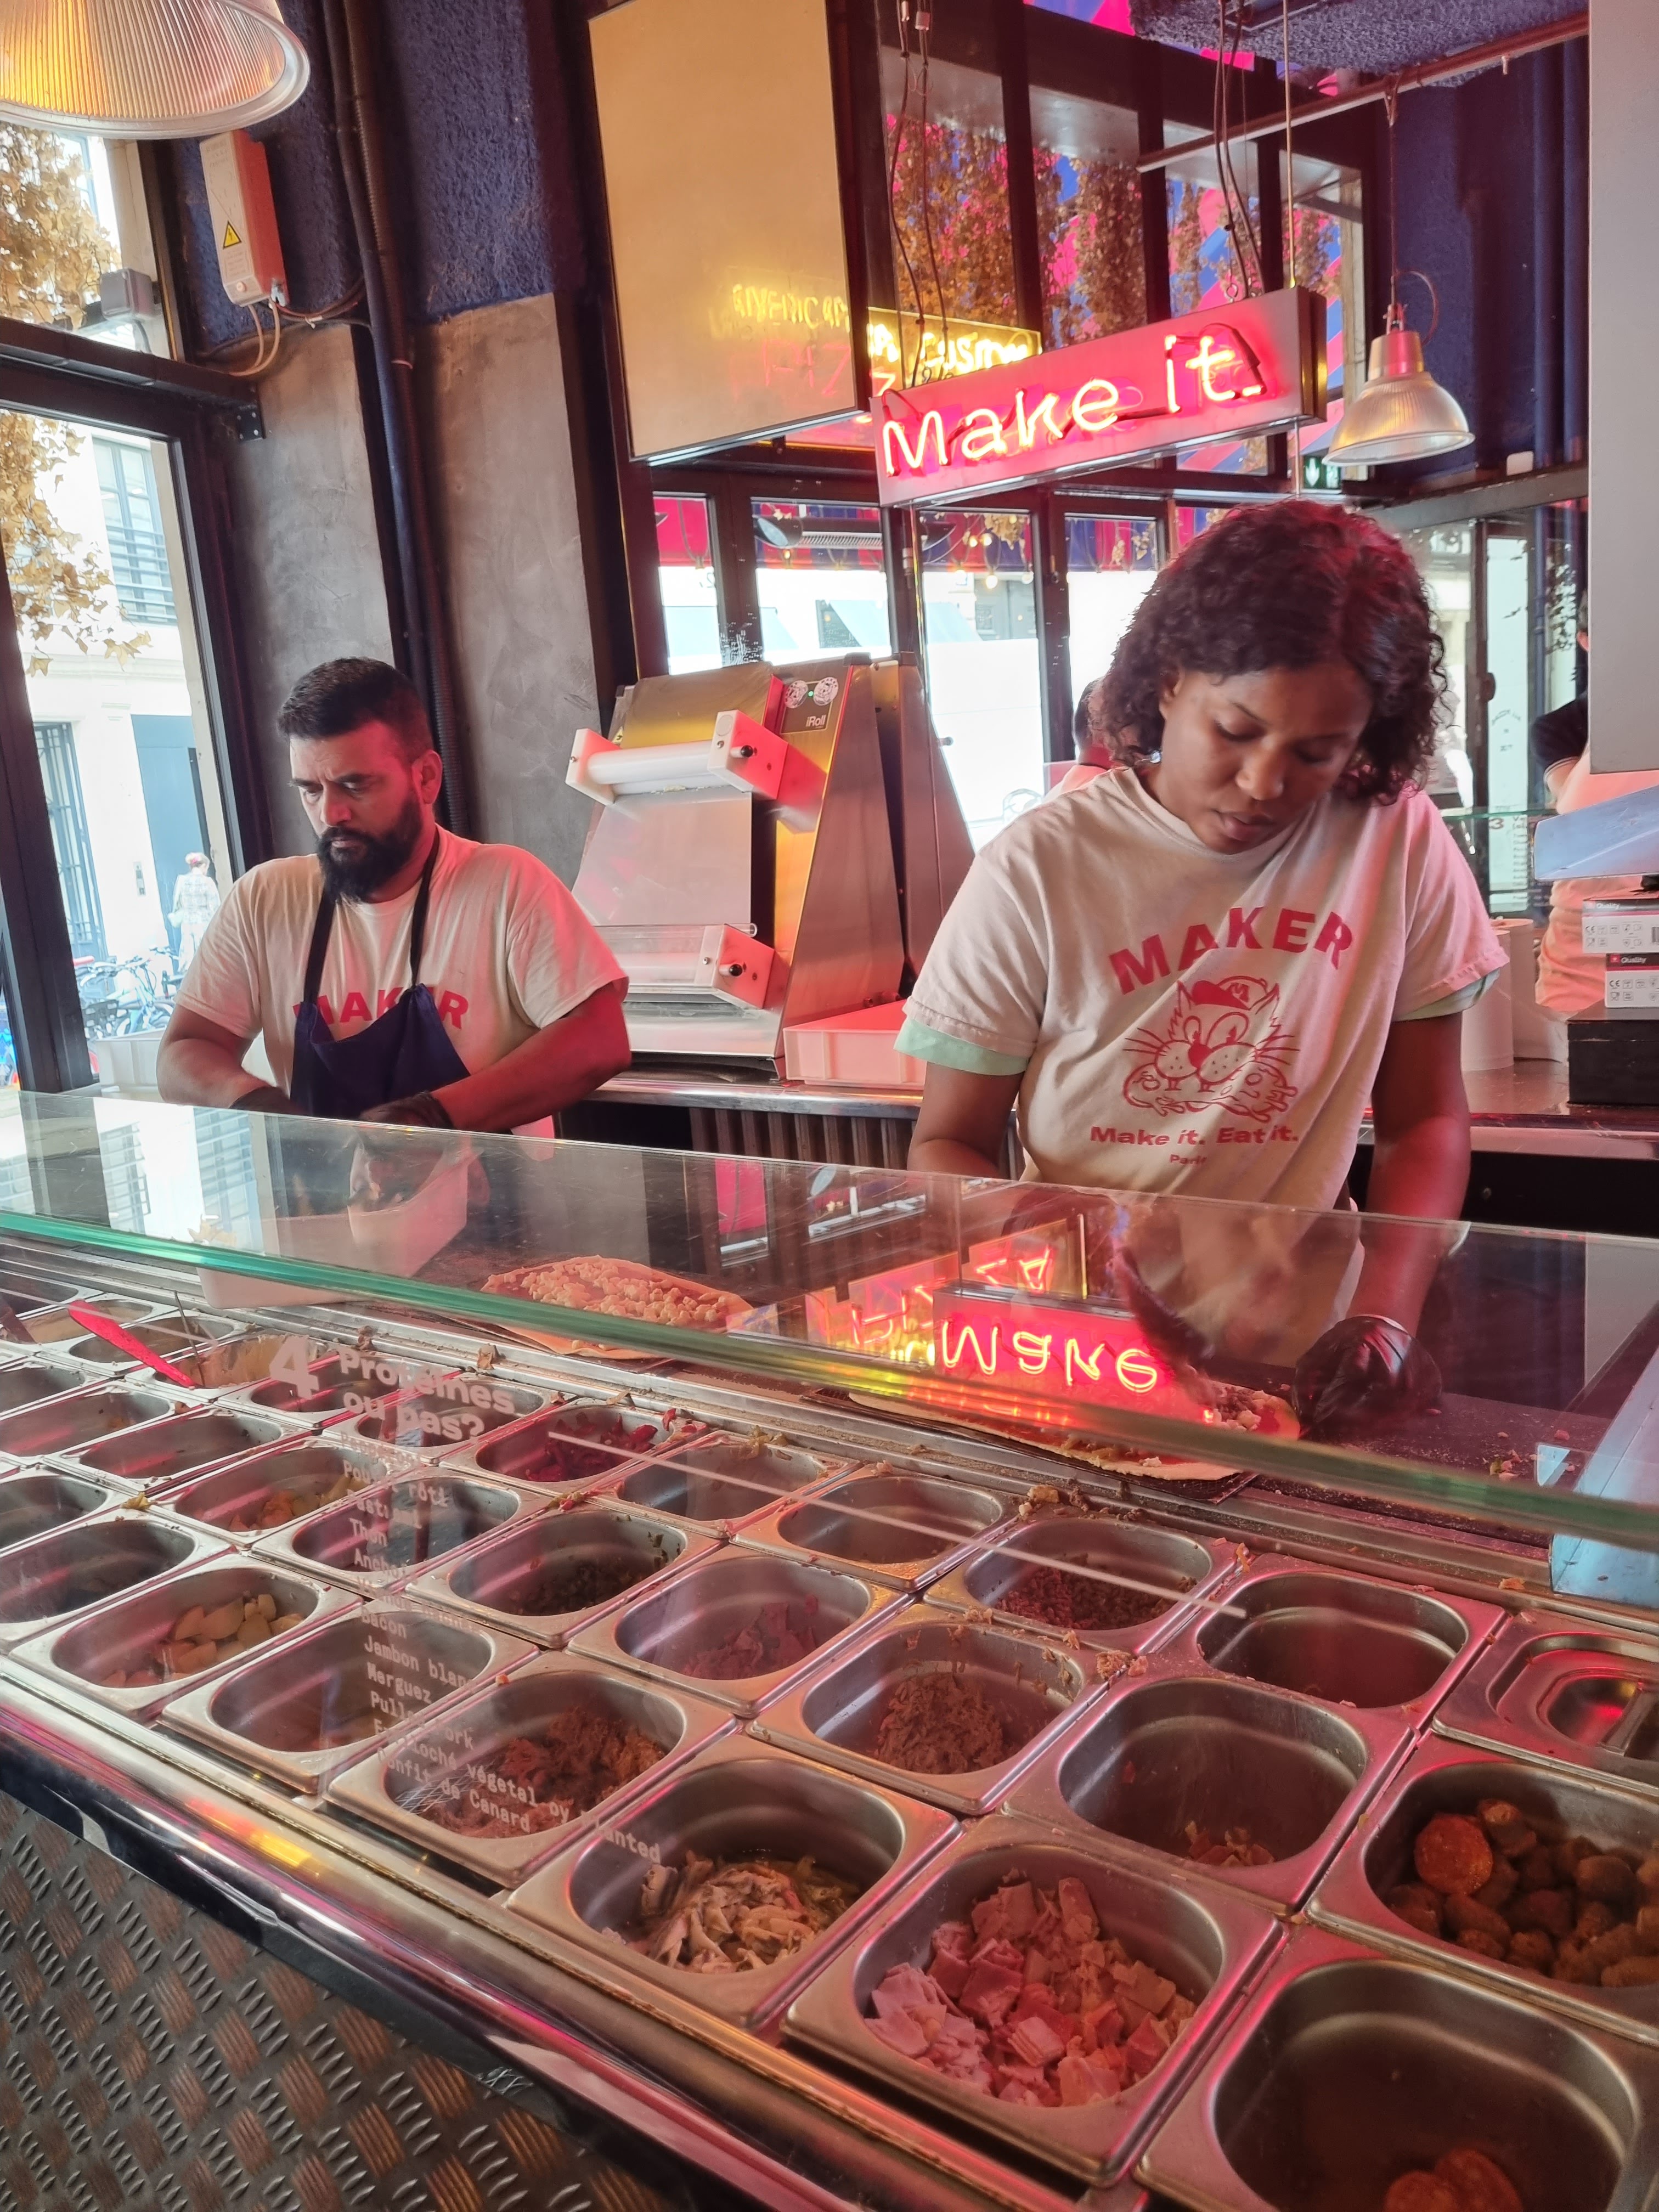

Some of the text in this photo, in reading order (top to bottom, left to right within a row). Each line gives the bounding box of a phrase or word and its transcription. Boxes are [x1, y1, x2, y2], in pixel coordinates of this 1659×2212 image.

[882, 335, 1266, 477] Make it.
[805, 714, 826, 727] iRoll
[1109, 906, 1353, 995] MAKER
[293, 987, 469, 1030] AKR
[1090, 1125, 1299, 1146] Make it. Eat it.
[268, 1334, 320, 1400] 4
[342, 1391, 485, 1443] ou pas?
[354, 1548, 419, 1585] Anchoi
[364, 1635, 419, 1672] Jambon
[367, 1661, 432, 1705] Merguez
[370, 1690, 425, 1729] Pull
[470, 1788, 531, 1833] Canard
